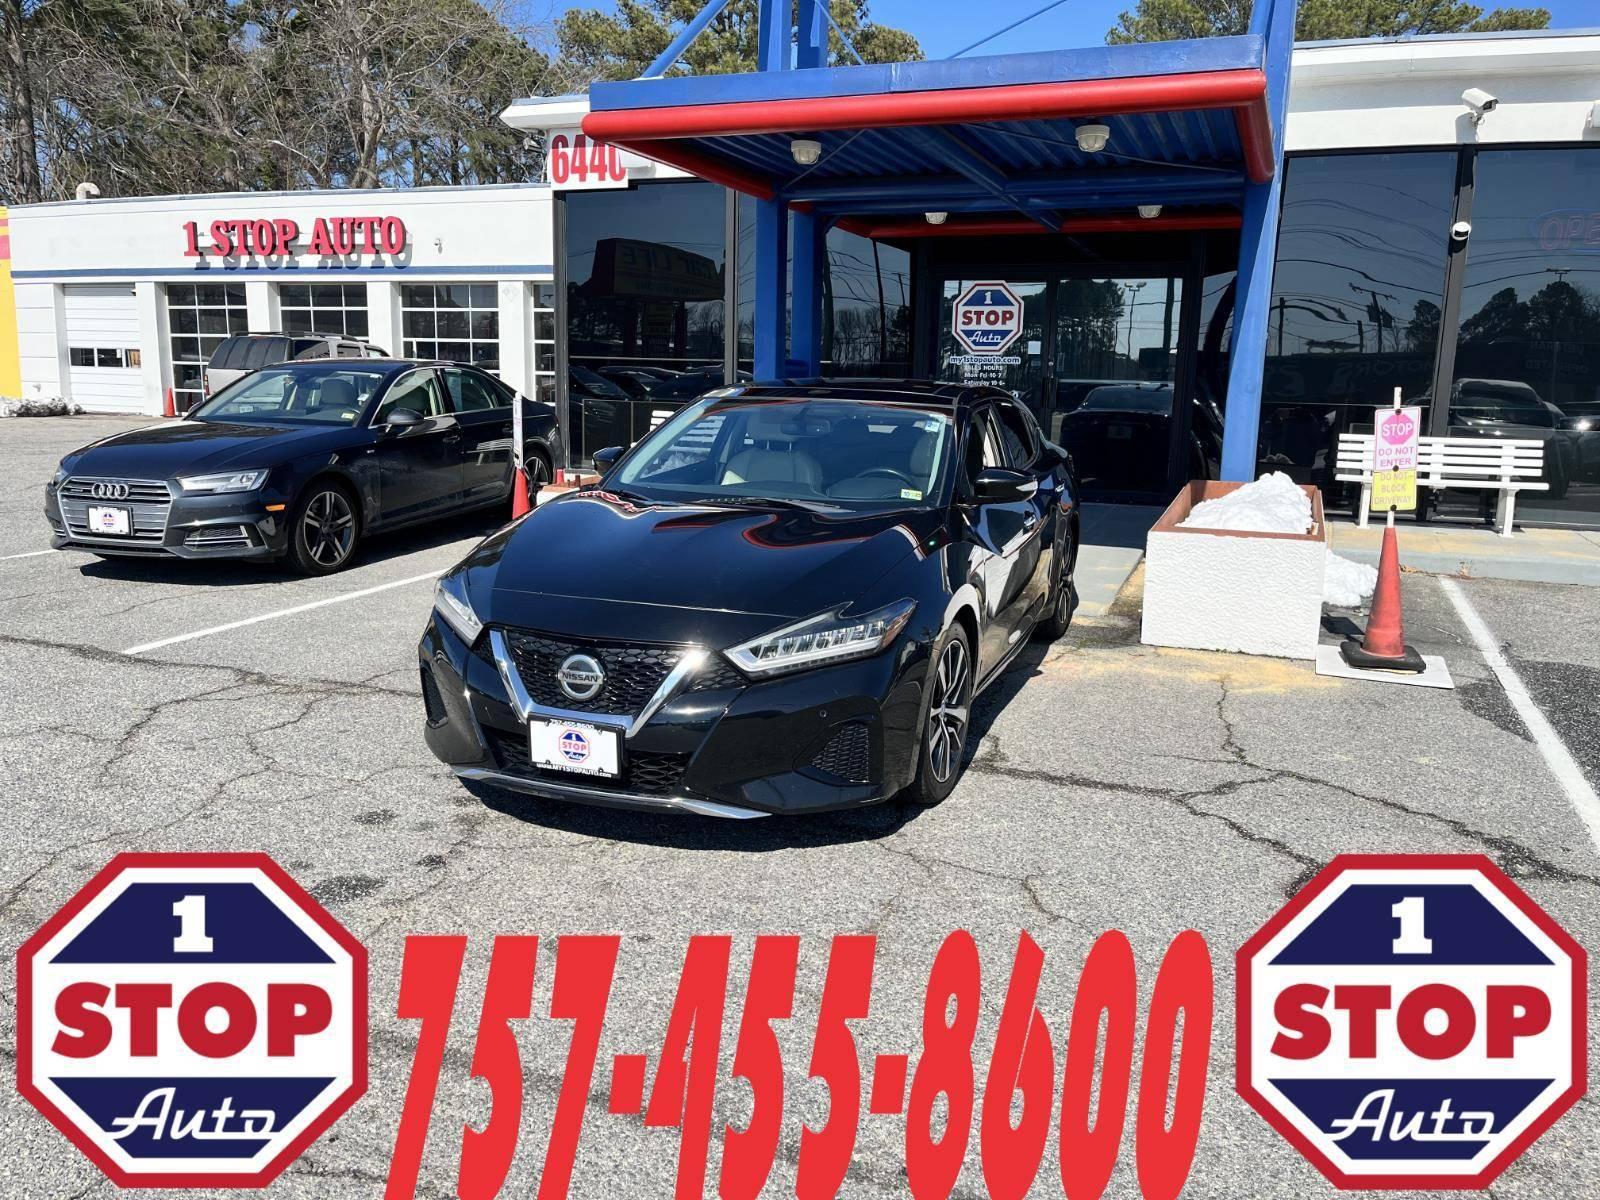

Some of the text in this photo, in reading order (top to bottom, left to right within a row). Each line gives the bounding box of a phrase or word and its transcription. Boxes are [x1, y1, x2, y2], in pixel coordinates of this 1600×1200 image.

[551, 134, 627, 184] 6440
[183, 216, 408, 257] 1 STOP AUTO
[984, 291, 993, 304] 1
[961, 309, 1015, 326] STOP
[968, 331, 1002, 343] Auto
[950, 355, 1021, 365] my1stopauto.com
[1382, 422, 1413, 437] STOP
[1378, 446, 1414, 457] DO NOT
[1380, 458, 1412, 467] ENTER
[1380, 473, 1391, 481] DO
[1381, 484, 1407, 493] BLOCK
[1373, 496, 1412, 505] DRIVEWAY
[562, 672, 599, 683] NISSAN
[562, 741, 587, 751] STOP
